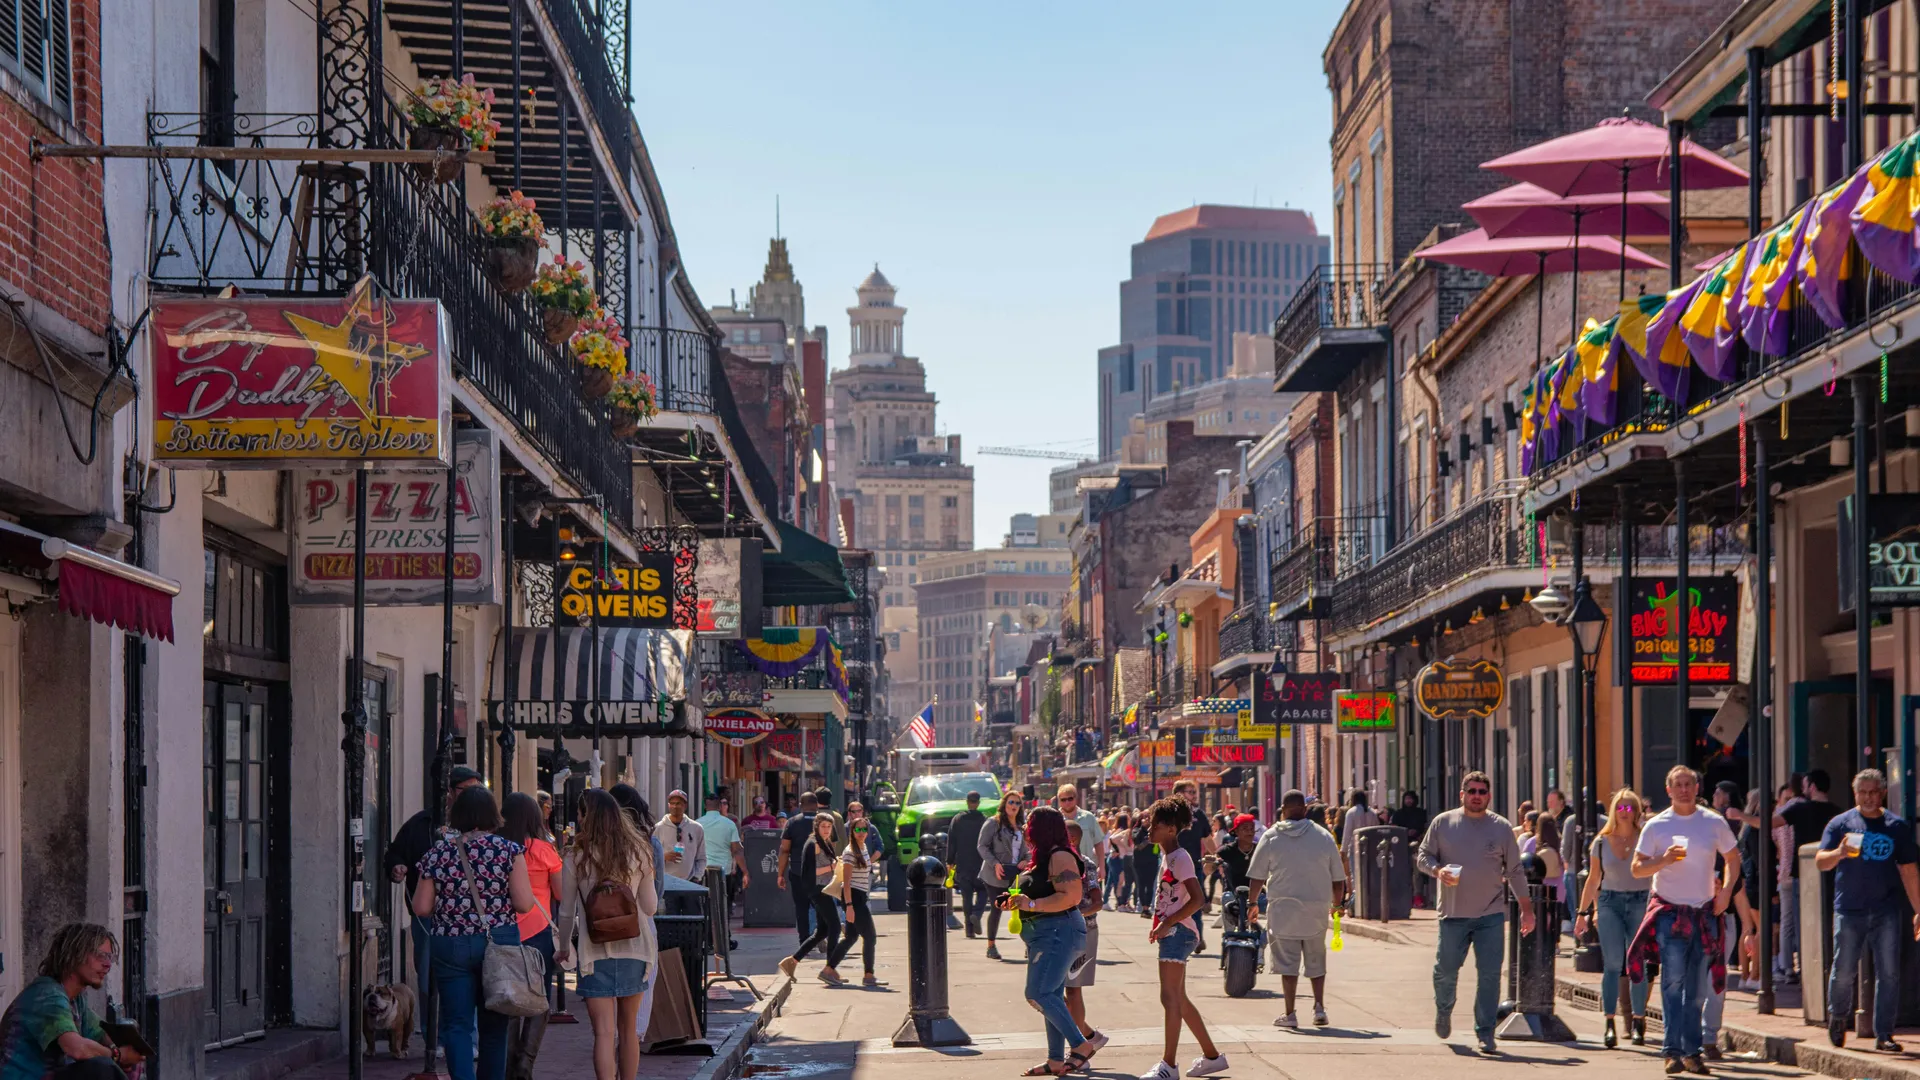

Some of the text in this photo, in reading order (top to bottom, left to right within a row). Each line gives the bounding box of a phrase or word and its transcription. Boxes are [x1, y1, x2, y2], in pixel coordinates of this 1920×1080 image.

[162, 364, 350, 428] Daddy's
[165, 423, 434, 456] Bottomless Topless
[335, 529, 447, 549] EPRESS
[364, 557, 385, 577] BY
[392, 556, 424, 577] THE
[427, 556, 476, 577] SLCE
[561, 594, 668, 618] OWENS
[1631, 606, 1668, 637] BIG
[1424, 682, 1500, 698] BANDSTAND
[584, 702, 674, 724] OWENS
[704, 718, 774, 731] DIXIELAND
[1245, 744, 1265, 761] CLUB
